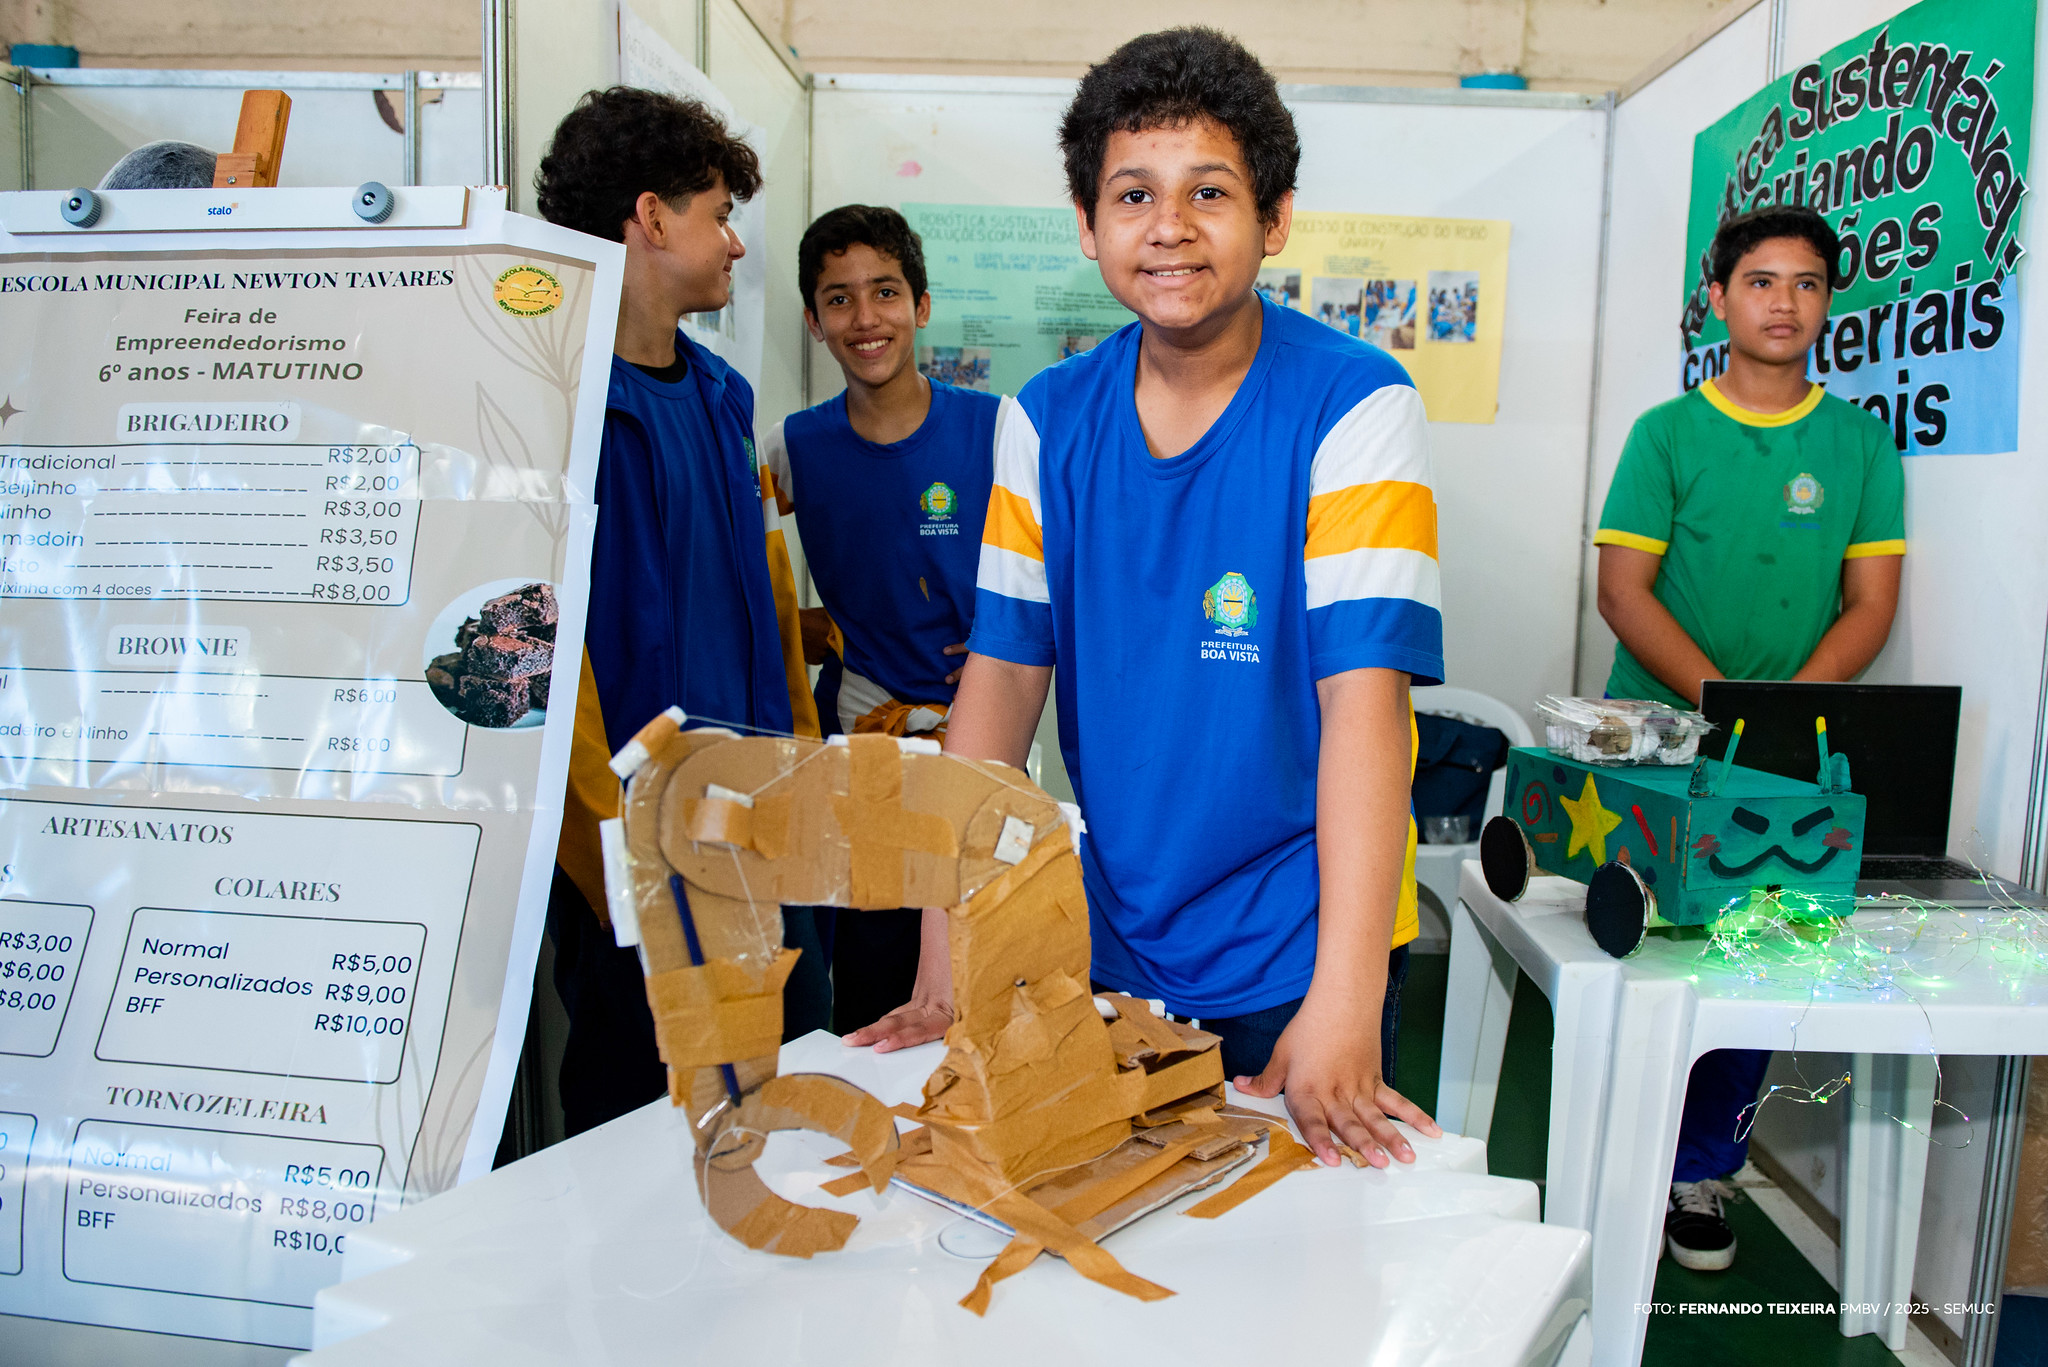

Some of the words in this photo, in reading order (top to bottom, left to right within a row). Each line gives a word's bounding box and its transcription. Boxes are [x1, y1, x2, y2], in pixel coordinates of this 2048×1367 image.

[207, 205, 232, 216] stalo
[1, 275, 88, 293] ESCOLA
[93, 273, 225, 291] MUNICIPAL
[231, 271, 339, 290] NEWTON
[345, 269, 454, 288] TAVARES
[184, 308, 241, 324] Feira
[249, 307, 277, 324] de
[116, 334, 346, 355] Empreendedorismo
[98, 364, 122, 382] 6º
[128, 365, 190, 381] anos
[212, 362, 364, 380] MATUTINO
[126, 413, 290, 433] BRIGADEIRO
[0, 454, 116, 470] Tradicional
[328, 445, 401, 466] R$2,00
[325, 475, 400, 493] R$2,00
[324, 500, 401, 519] R$3,00
[320, 528, 398, 547] R$3,50
[937, 528, 959, 536] VISTA
[316, 555, 394, 575] R$3,50
[52, 585, 88, 595] com
[92, 584, 102, 595] 4
[105, 583, 152, 595] doces
[312, 582, 390, 602] R$8,00
[118, 636, 238, 657] BROWNIE
[1201, 640, 1260, 652] PREFEITURA
[1201, 649, 1227, 660] BOA
[1229, 650, 1260, 663] VISTA
[62, 729, 73, 738] e
[79, 725, 128, 741] Ninho
[41, 815, 235, 845] ARTESANATOS
[214, 876, 343, 903] COLARES
[0, 931, 73, 953] R$3,00
[142, 937, 230, 960] Normal
[332, 952, 413, 977] R$5,00
[134, 966, 314, 996] Personalizados
[325, 983, 407, 1006] R$9,00
[125, 996, 165, 1015] BFF
[314, 1013, 404, 1038] R$10,00
[106, 1085, 328, 1125] TORNOZELEIRA
[83, 1145, 172, 1172] Normal
[284, 1164, 370, 1191] R$5,00
[79, 1178, 263, 1213] Personalizados
[280, 1196, 366, 1225] R$8,00
[77, 1210, 116, 1230] BFF
